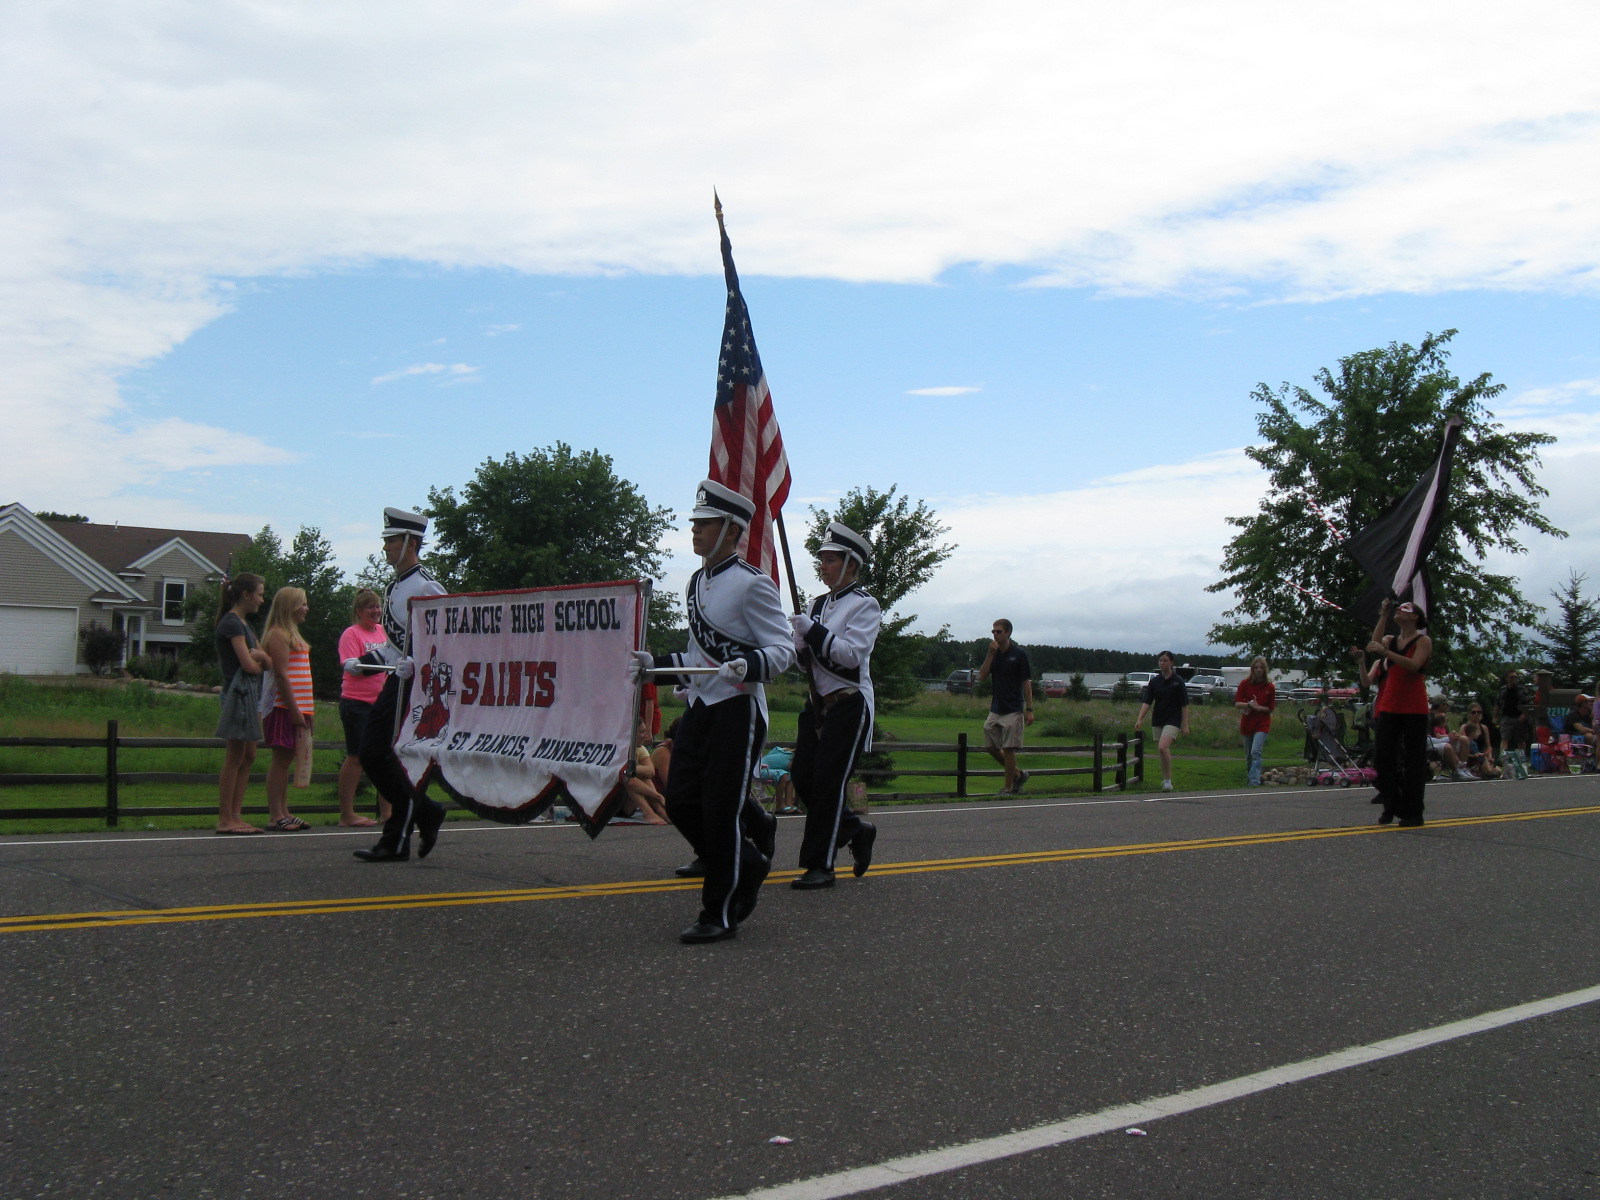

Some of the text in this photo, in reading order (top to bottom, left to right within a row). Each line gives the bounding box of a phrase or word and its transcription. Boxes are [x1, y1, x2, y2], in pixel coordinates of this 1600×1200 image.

[445, 605, 503, 634] FRANCIS
[511, 602, 545, 633] HIGH
[555, 598, 620, 631] SCHOOL
[461, 661, 557, 708] SAINTS
[447, 731, 617, 767] ST. FRANCIS, MINNESOTA
